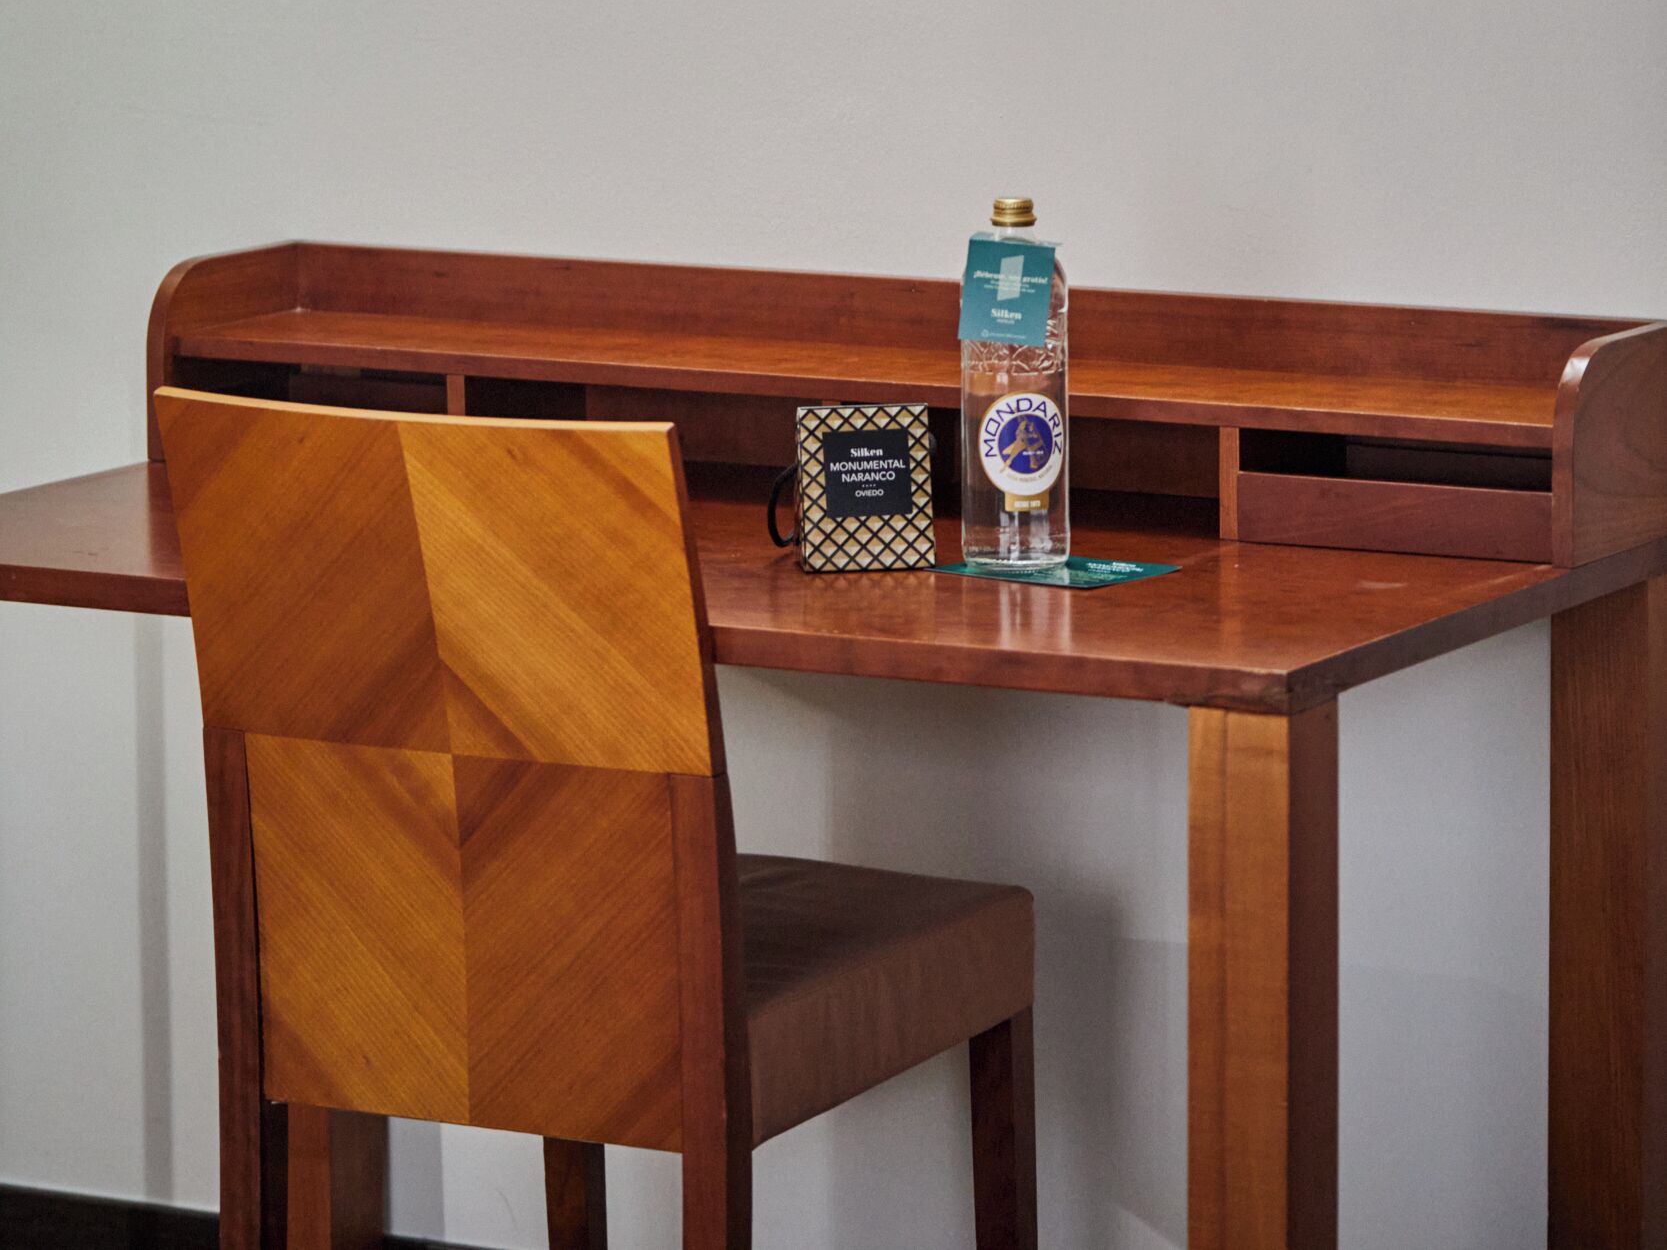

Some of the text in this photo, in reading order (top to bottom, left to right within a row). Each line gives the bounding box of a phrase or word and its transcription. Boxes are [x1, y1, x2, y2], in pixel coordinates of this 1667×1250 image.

[991, 308, 1022, 319] Silken
[984, 398, 1063, 458] MONDARIZ
[850, 447, 884, 458] Silken
[830, 459, 906, 472] MONUMENTAL
[841, 471, 896, 482] NARANCO
[855, 489, 884, 497] OVIEDO
